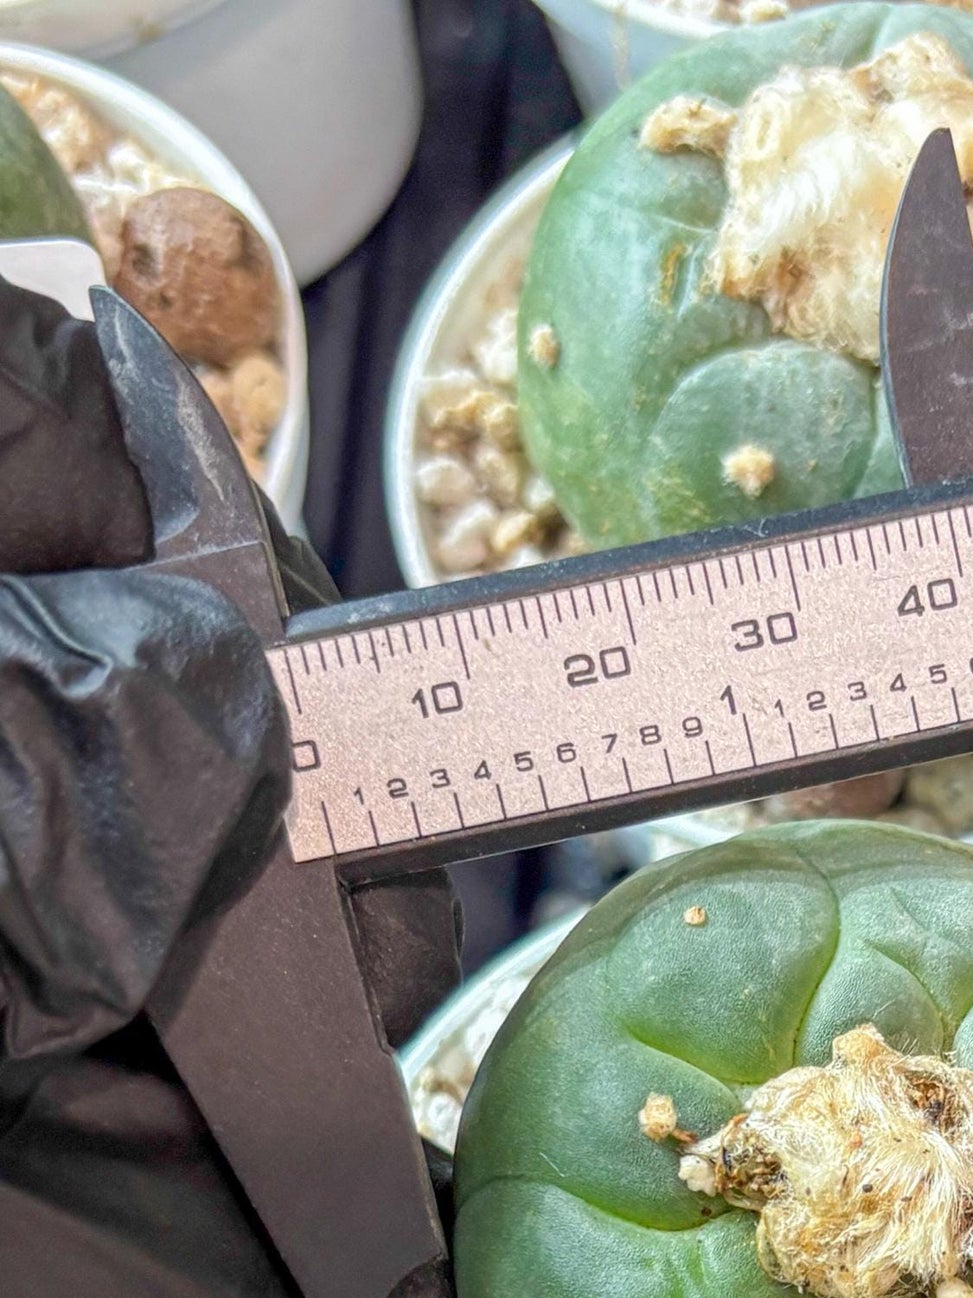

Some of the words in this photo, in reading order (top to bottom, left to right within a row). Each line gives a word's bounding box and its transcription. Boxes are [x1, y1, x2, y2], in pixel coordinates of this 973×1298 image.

[411, 681, 463, 719] 10
[563, 646, 631, 688] 20
[731, 612, 798, 653] 30
[897, 578, 958, 617] 40
[354, 787, 366, 805] 1
[386, 778, 409, 799] 2
[430, 769, 451, 788] 3
[474, 760, 492, 780] 4
[513, 751, 534, 772] 5
[556, 742, 576, 763] 6
[600, 733, 618, 754] 7
[639, 725, 661, 745] 8
[682, 717, 703, 738] 9
[720, 685, 738, 715] 1
[774, 699, 786, 718] 1
[806, 691, 827, 711] 2
[847, 681, 867, 701] 3
[889, 673, 908, 692] 4
[929, 664, 948, 684] 5
